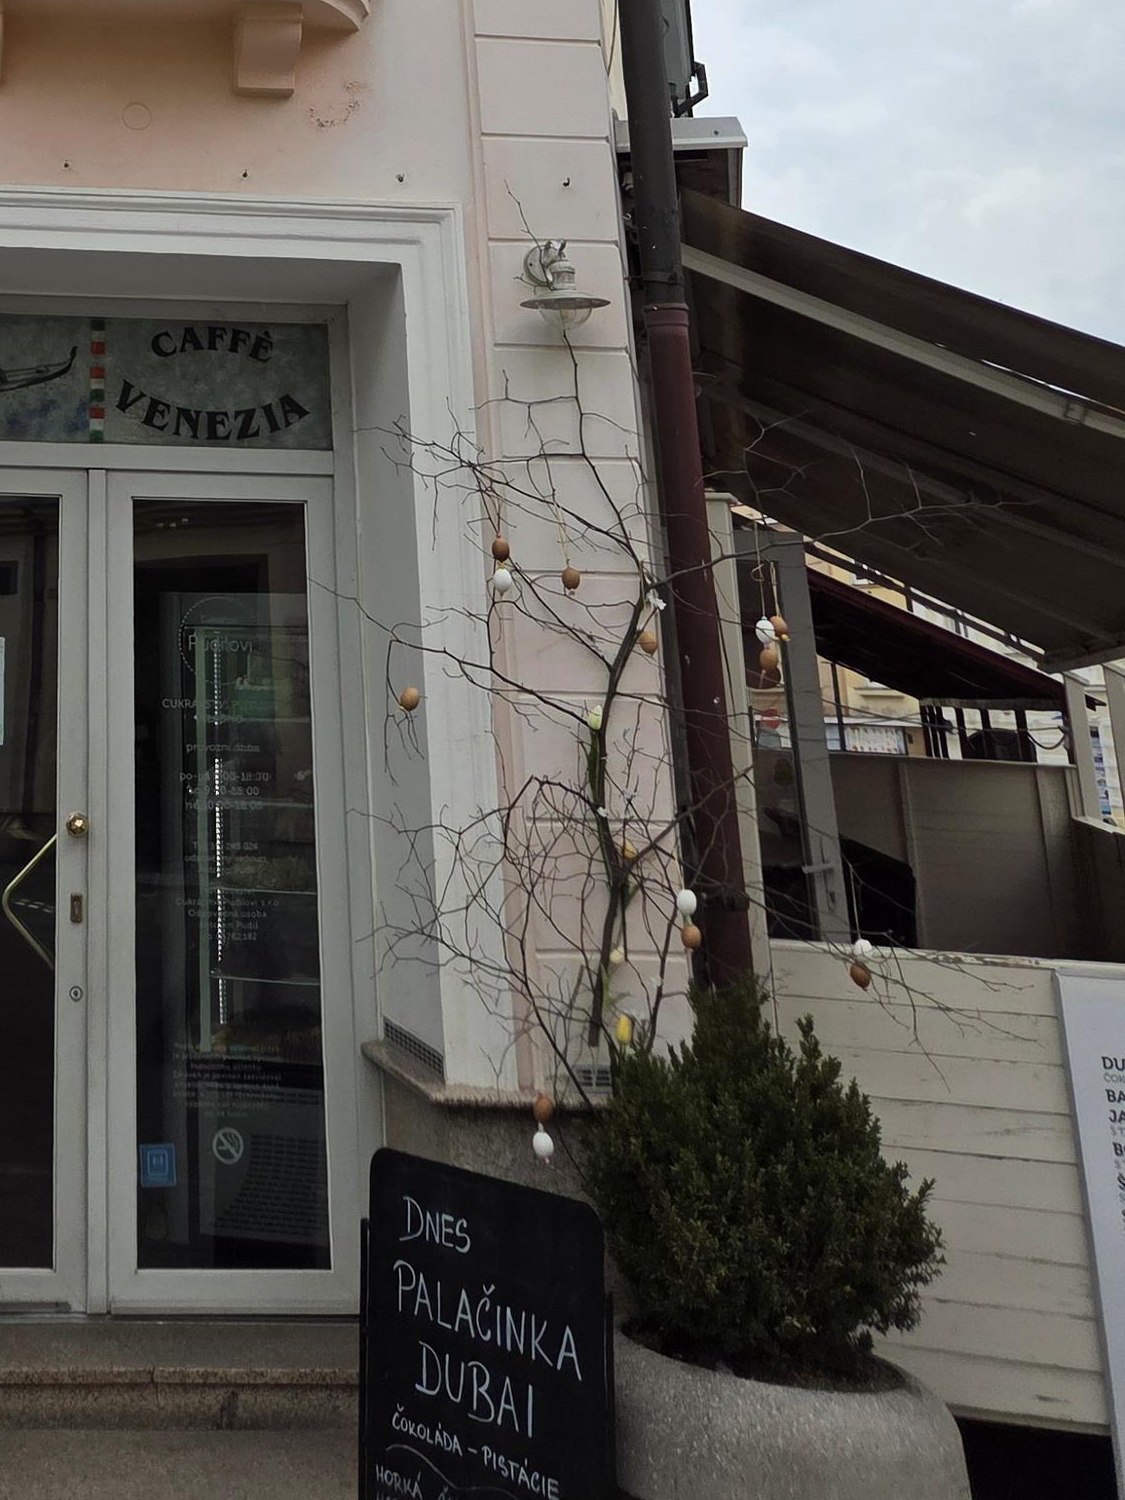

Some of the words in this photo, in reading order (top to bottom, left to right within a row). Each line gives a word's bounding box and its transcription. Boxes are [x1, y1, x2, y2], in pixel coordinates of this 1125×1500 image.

[151, 326, 274, 363] CAFFÈ
[114, 378, 310, 441] VENEZIA
[398, 1195, 472, 1254] DNES
[393, 1259, 583, 1382] PALAČINKA
[414, 1340, 534, 1439] DUBAI
[375, 1463, 423, 1500] HORKÁ
[391, 1403, 463, 1457] ČOKOLÁDA
[481, 1445, 561, 1500] PISTÁCIE
